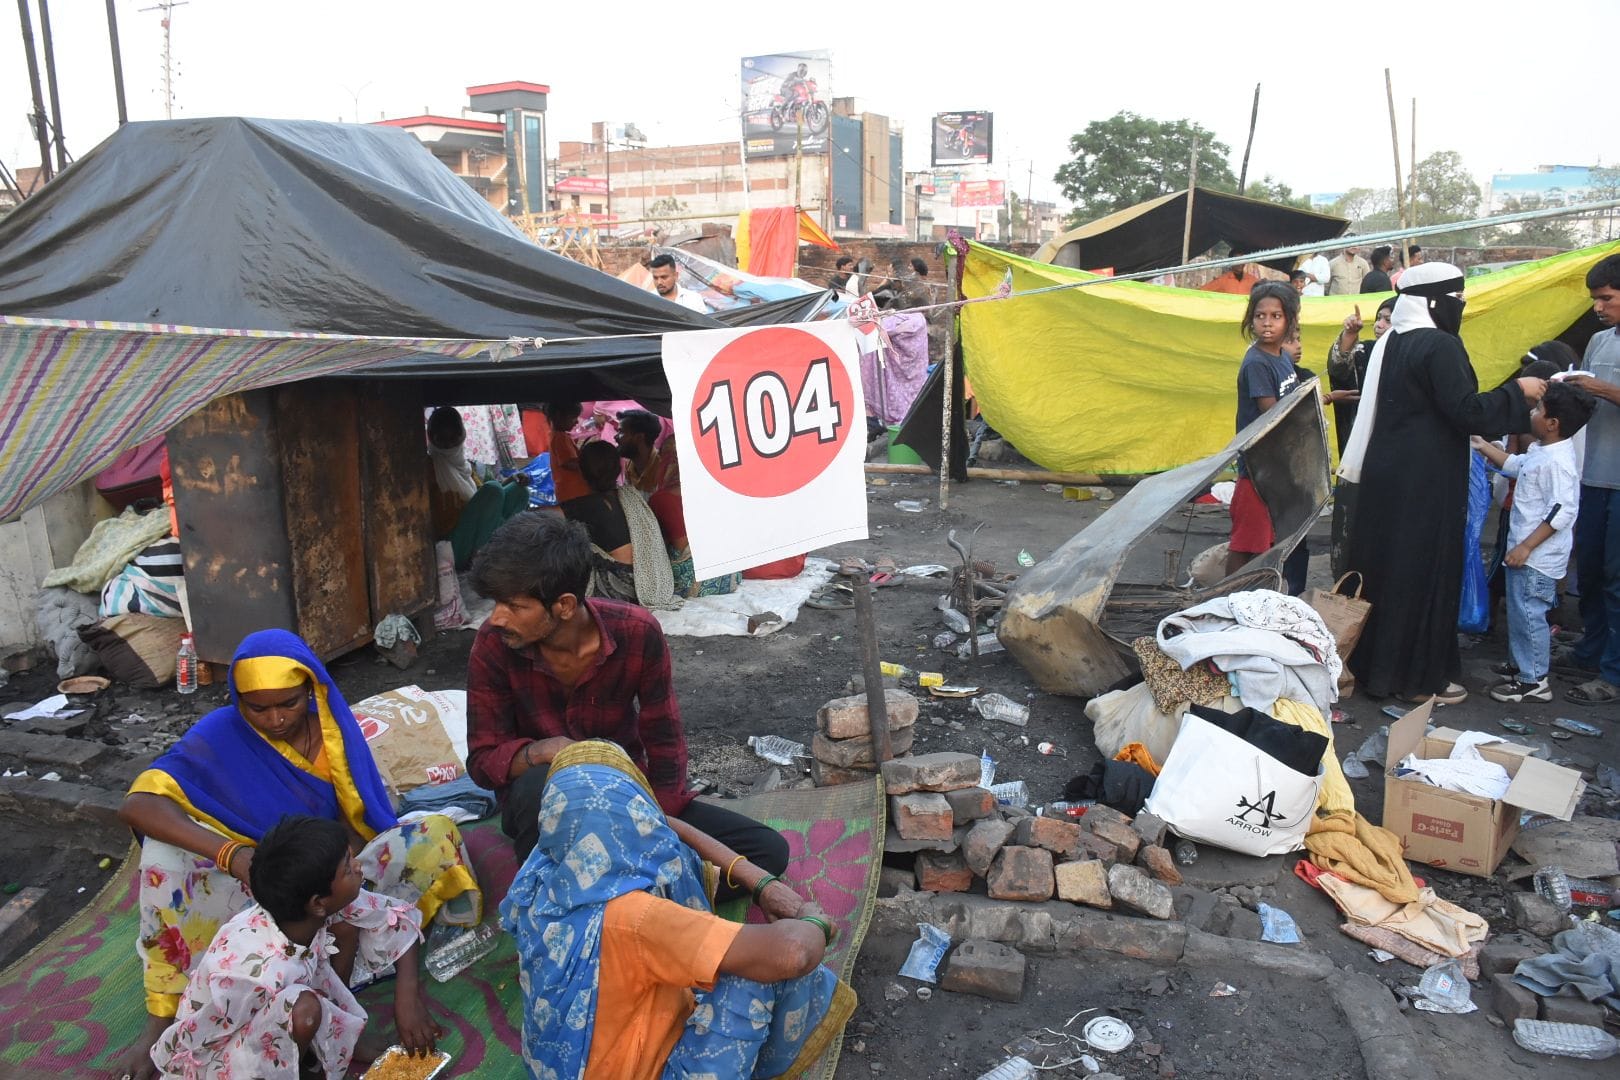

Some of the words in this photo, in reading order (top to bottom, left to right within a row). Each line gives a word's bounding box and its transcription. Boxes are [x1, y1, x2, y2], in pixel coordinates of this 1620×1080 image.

[696, 357, 843, 470] 104
[1225, 817, 1273, 837] ARROW
[1416, 822, 1459, 838] Parle-G
